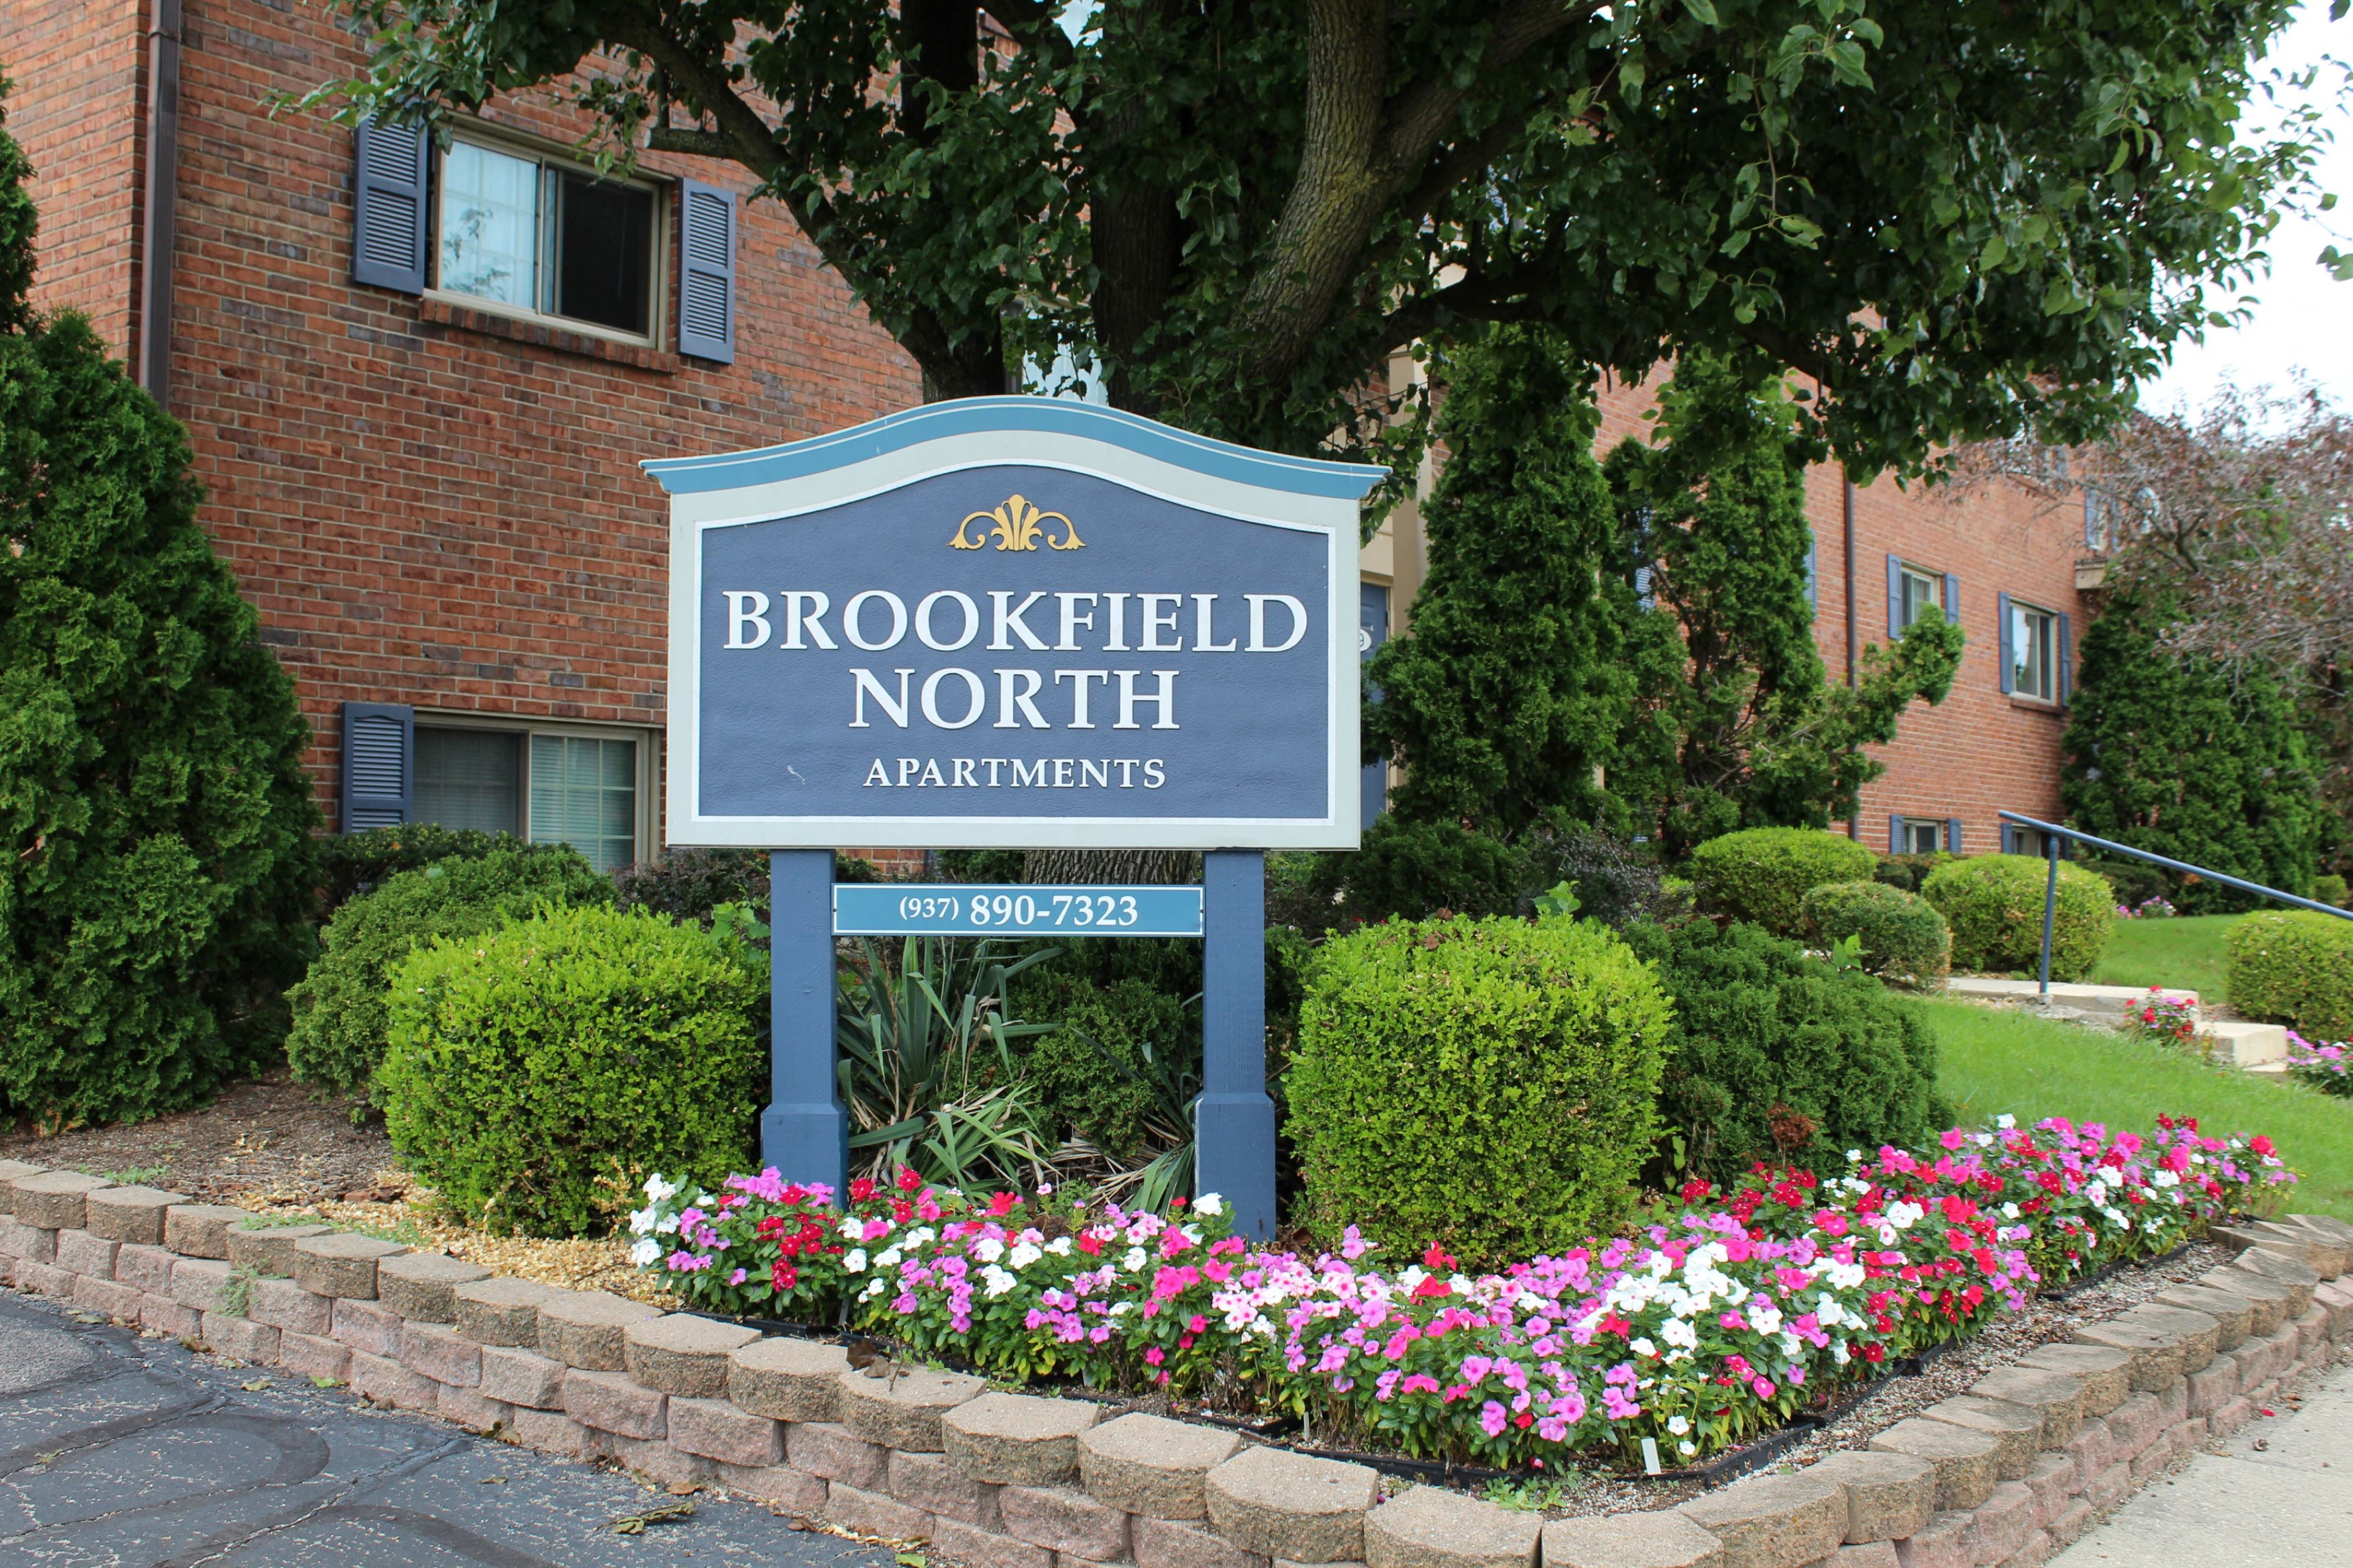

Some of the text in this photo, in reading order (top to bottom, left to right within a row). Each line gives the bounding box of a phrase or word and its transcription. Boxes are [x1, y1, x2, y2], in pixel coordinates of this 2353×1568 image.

[722, 590, 1308, 652] BROOKFIELD
[848, 667, 1180, 729] NORTH
[863, 758, 1166, 788] APARTMENTS
[900, 895, 1138, 926] (937) 890-7323
